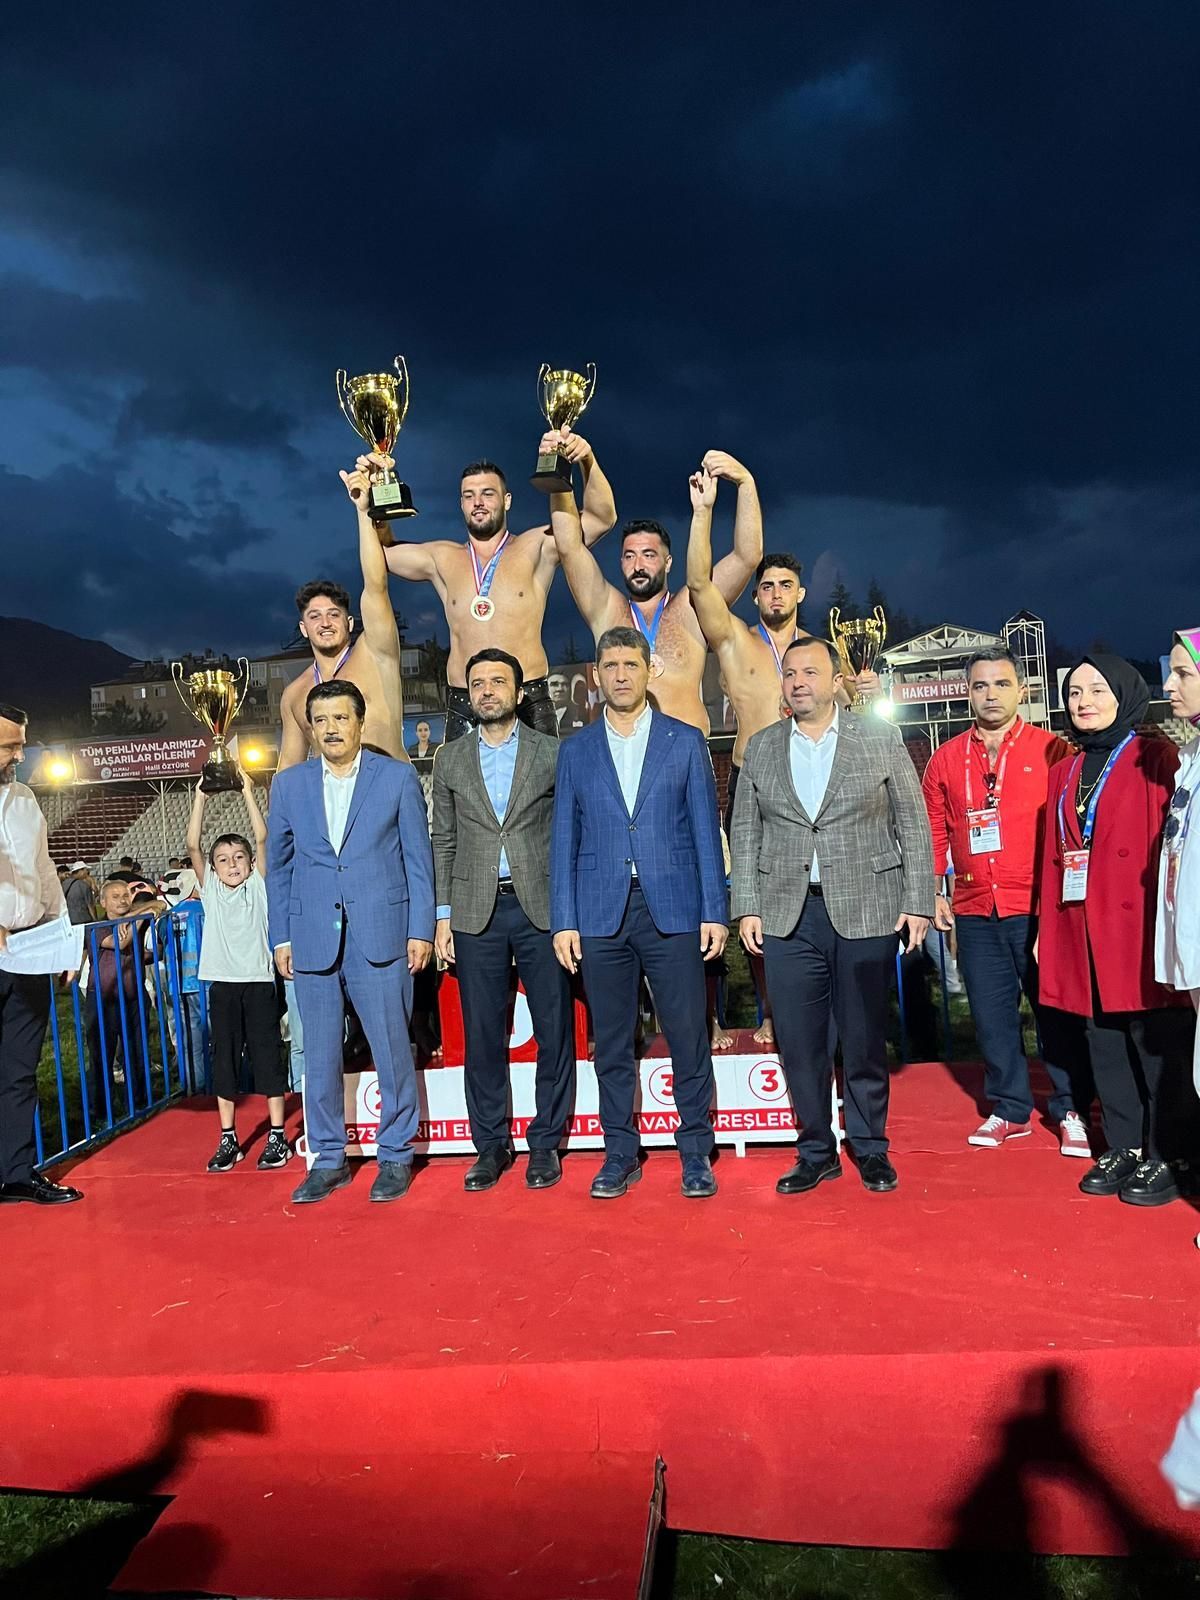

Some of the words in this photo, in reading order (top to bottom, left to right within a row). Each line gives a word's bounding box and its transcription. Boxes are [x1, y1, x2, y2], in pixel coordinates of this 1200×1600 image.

[902, 685, 939, 699] HAKEM
[941, 682, 967, 696] HEYE
[80, 746, 103, 758] TÜM
[105, 739, 206, 756] PEHLİVANLARIMIZA
[93, 753, 152, 767] BAŞARILAR
[154, 748, 196, 761] DİLERİM
[161, 761, 190, 770] ÖZTÜRK
[661, 1073, 674, 1097] 3
[760, 1069, 779, 1092] 3
[416, 1121, 447, 1138] RİHİ
